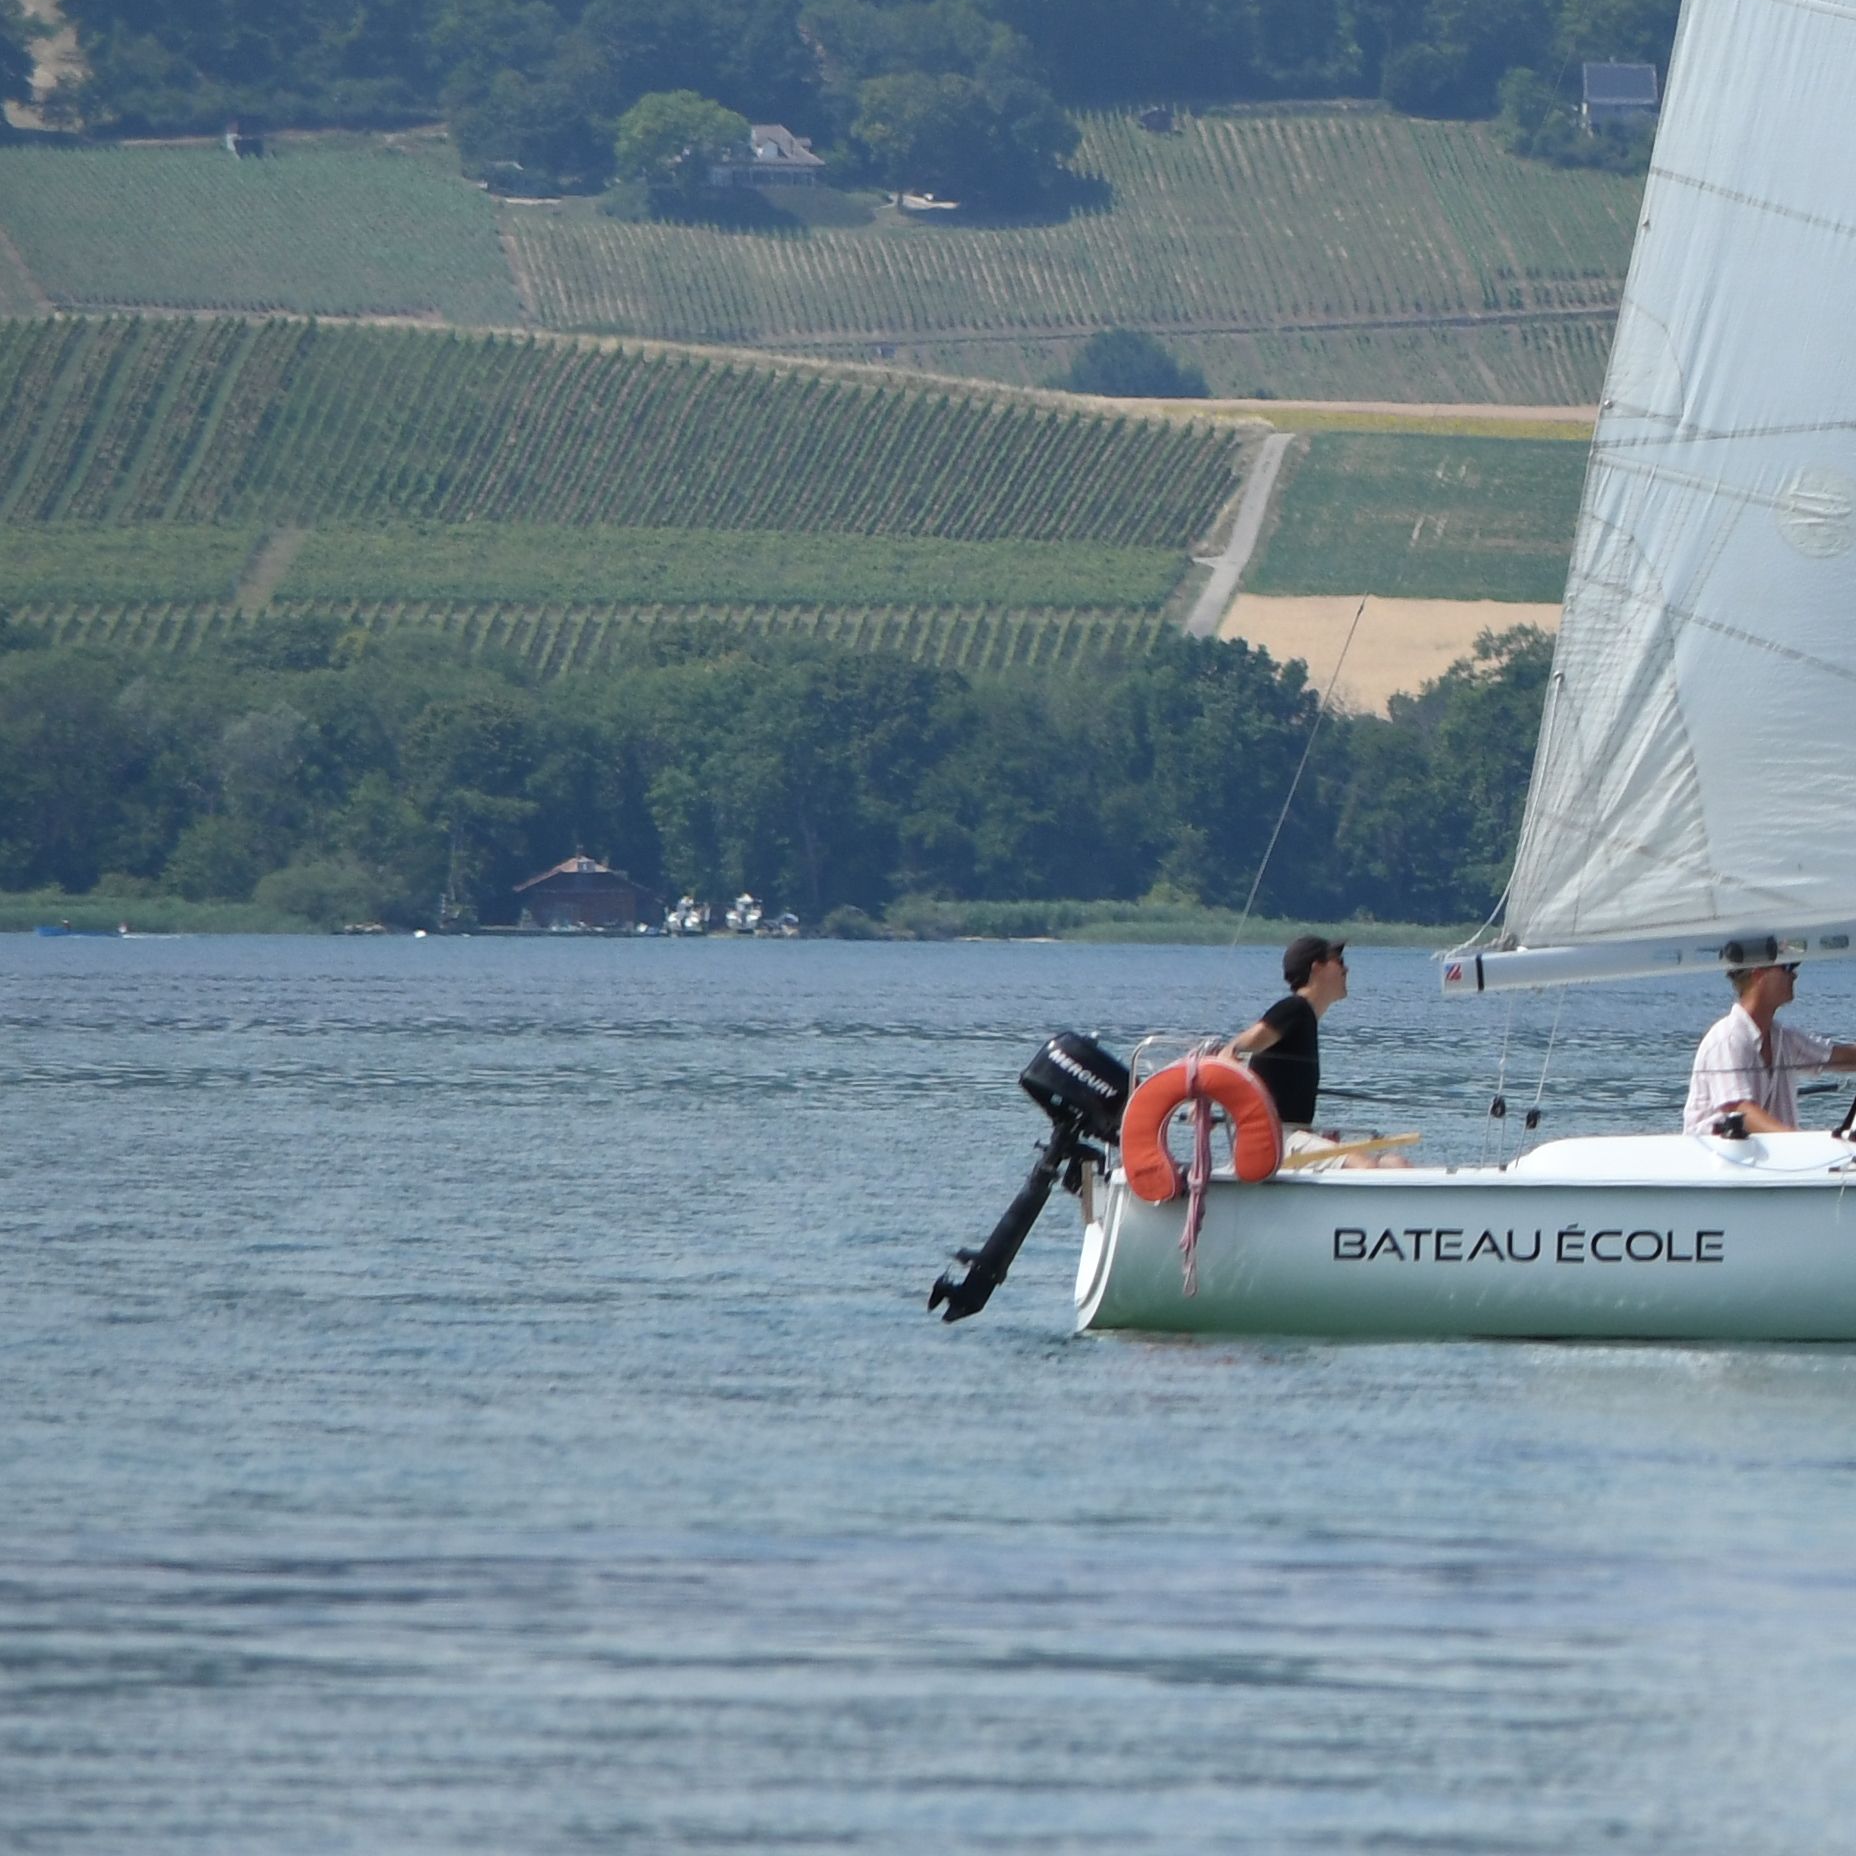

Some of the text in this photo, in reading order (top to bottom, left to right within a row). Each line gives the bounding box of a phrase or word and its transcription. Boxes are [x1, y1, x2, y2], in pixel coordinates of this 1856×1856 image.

[1048, 1048, 1118, 1099] MERCURY
[1332, 1223, 1725, 1264] BATEAU ÉCOLE
